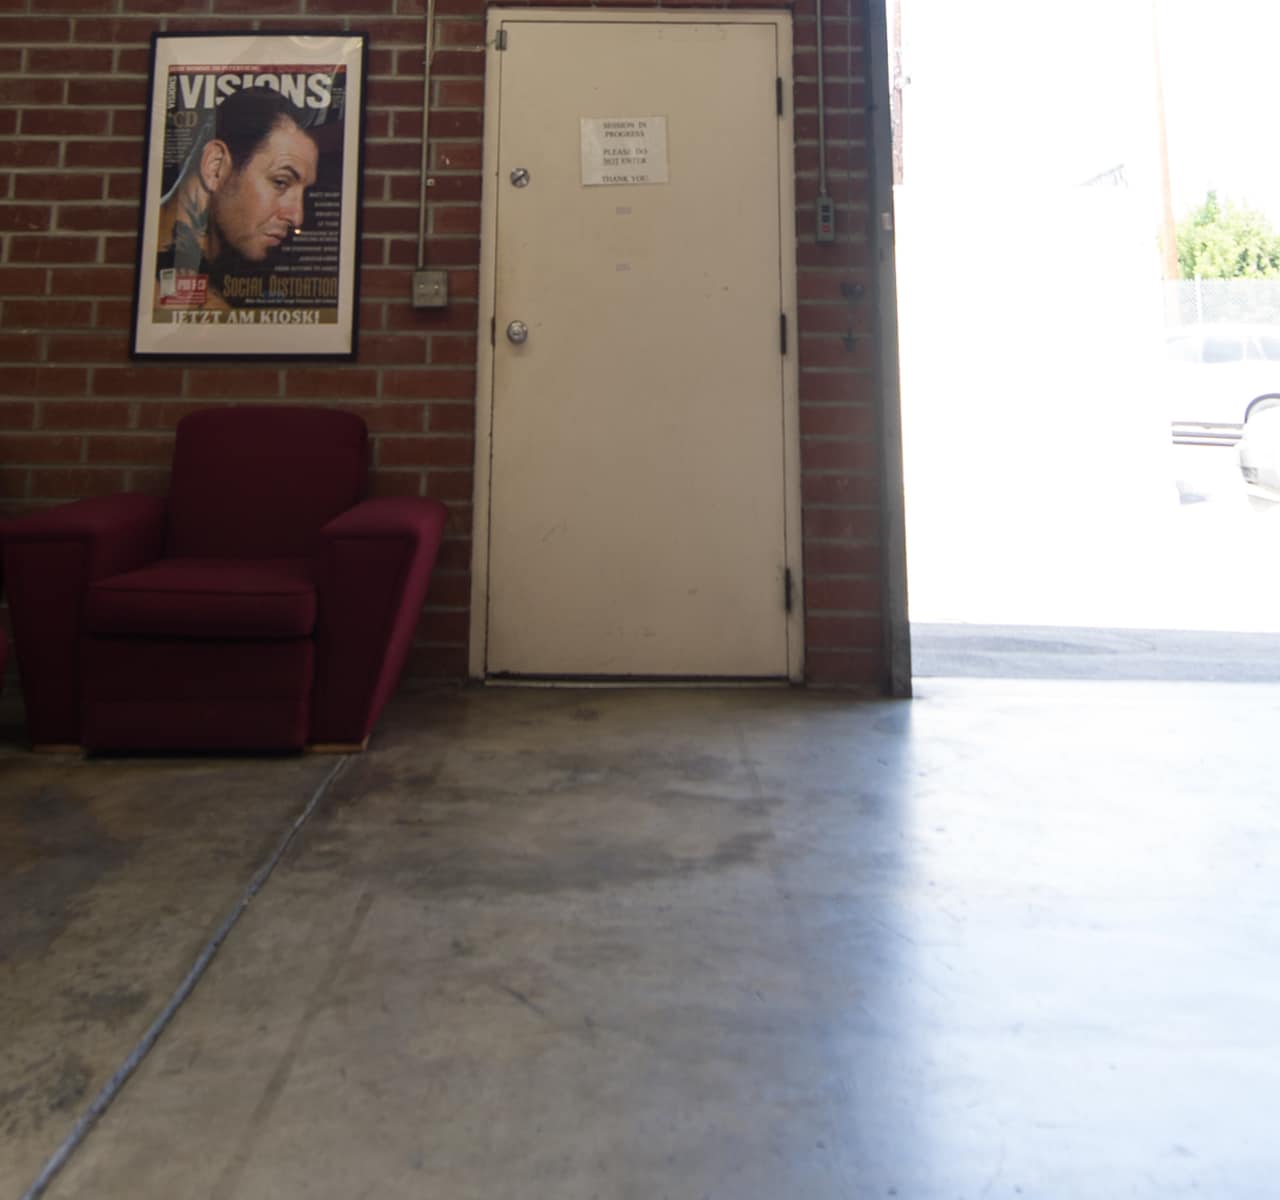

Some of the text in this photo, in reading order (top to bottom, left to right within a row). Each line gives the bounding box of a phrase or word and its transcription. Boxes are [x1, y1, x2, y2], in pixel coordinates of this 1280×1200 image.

[223, 273, 263, 298] SOCIAL
[171, 310, 320, 324] JETZT AM KIOSK!
